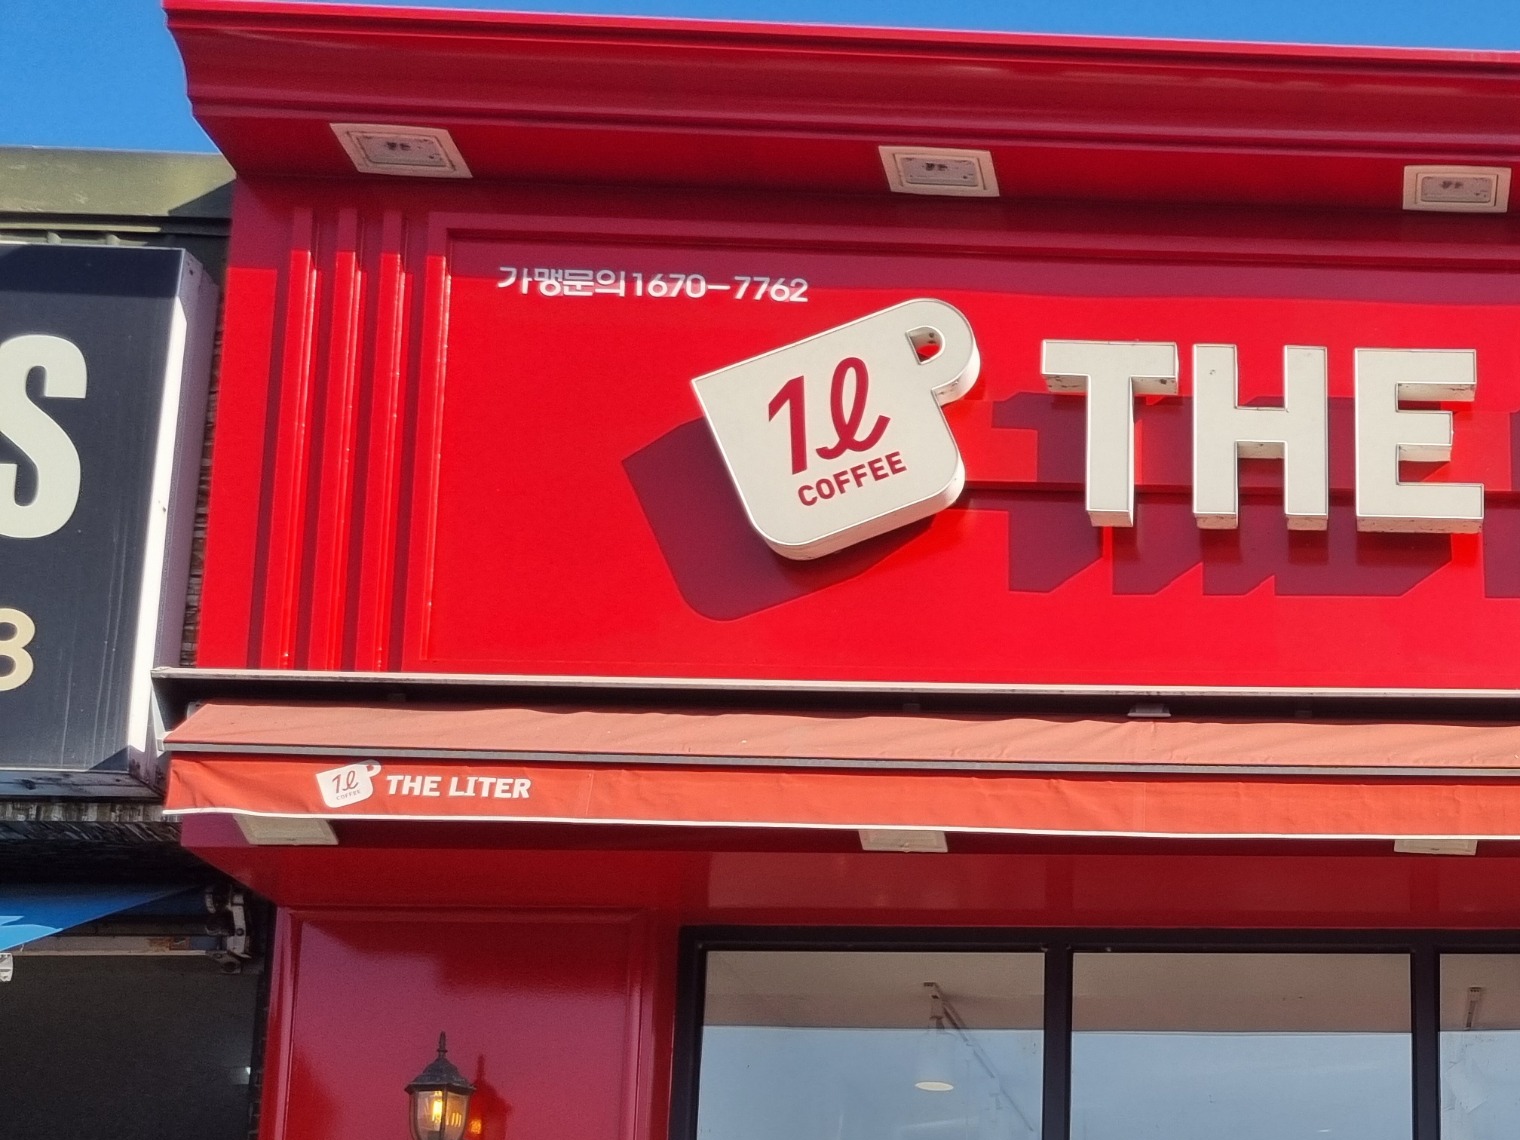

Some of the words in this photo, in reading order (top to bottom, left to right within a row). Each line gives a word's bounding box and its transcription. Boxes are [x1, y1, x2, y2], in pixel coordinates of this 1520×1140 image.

[1040, 338, 1485, 534] THE
[797, 450, 907, 507] COFFEE
[386, 775, 442, 796] THE
[448, 776, 532, 799] LITER
